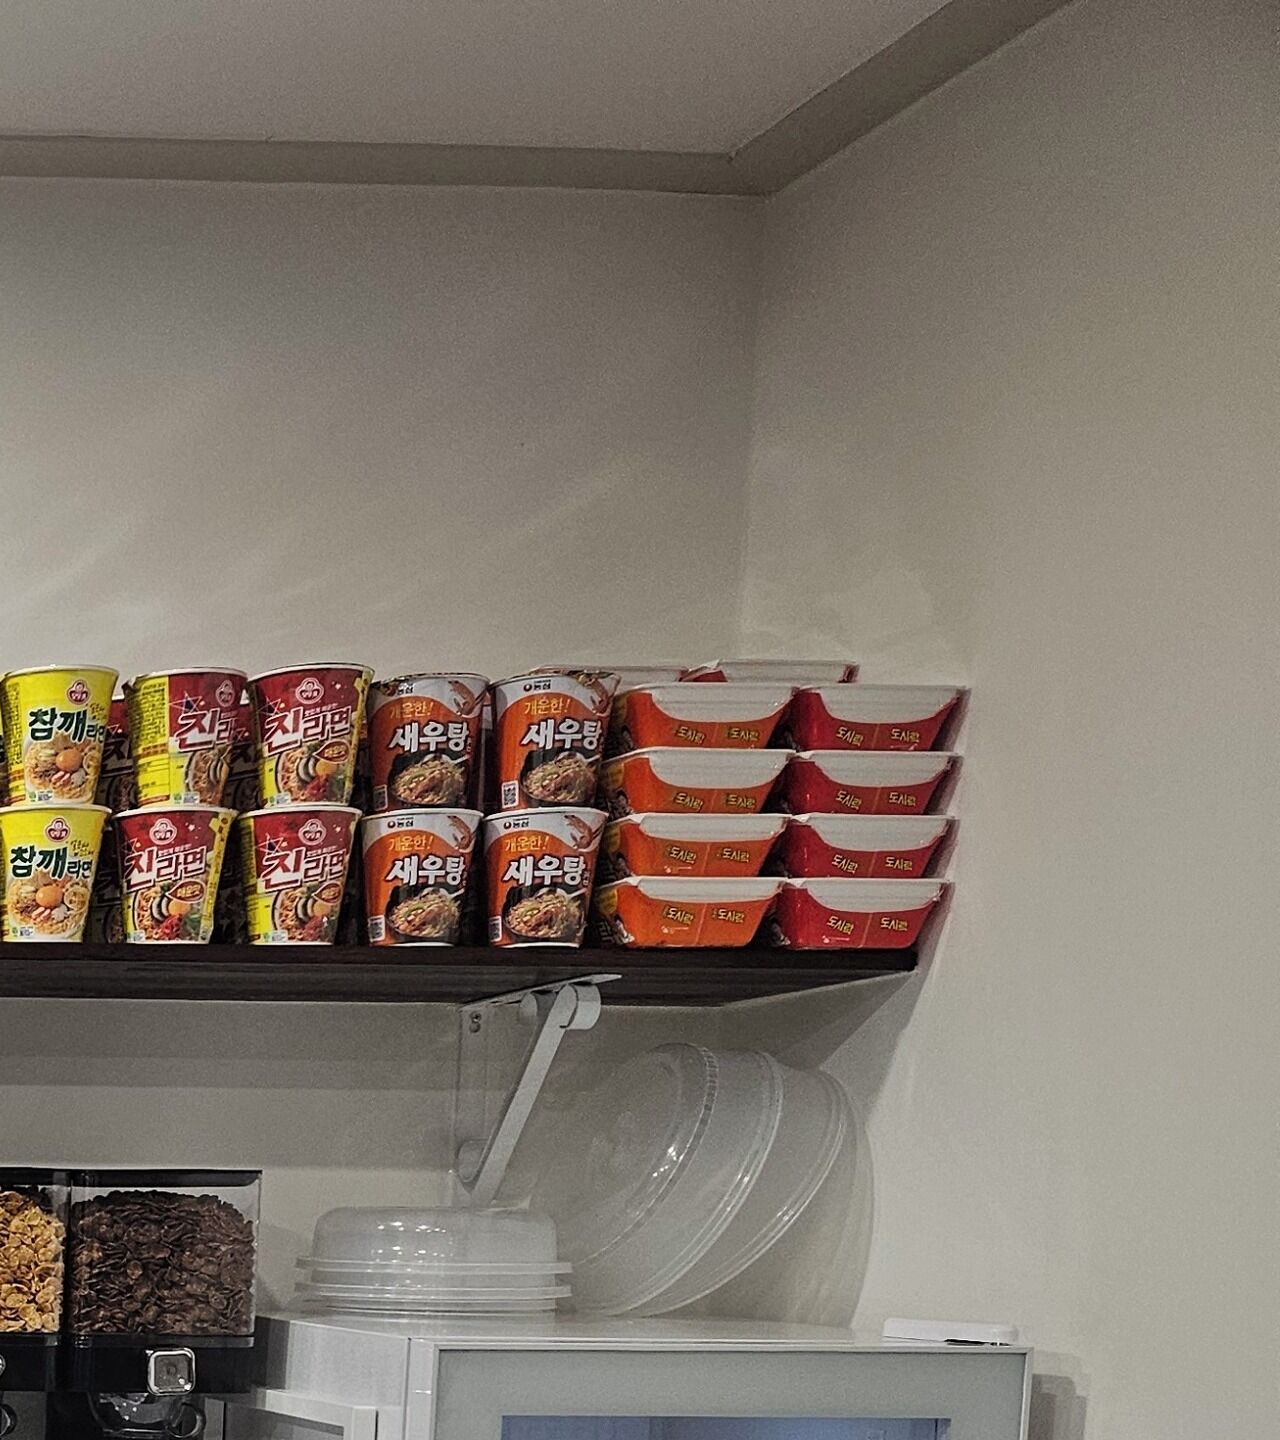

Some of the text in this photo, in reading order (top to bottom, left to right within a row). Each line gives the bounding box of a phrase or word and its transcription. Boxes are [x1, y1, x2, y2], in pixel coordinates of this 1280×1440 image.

[389, 719, 469, 753] 새우탕
[521, 718, 603, 750] 새우탕
[385, 855, 465, 886] 새우탕
[502, 855, 587, 886] 새우탕
